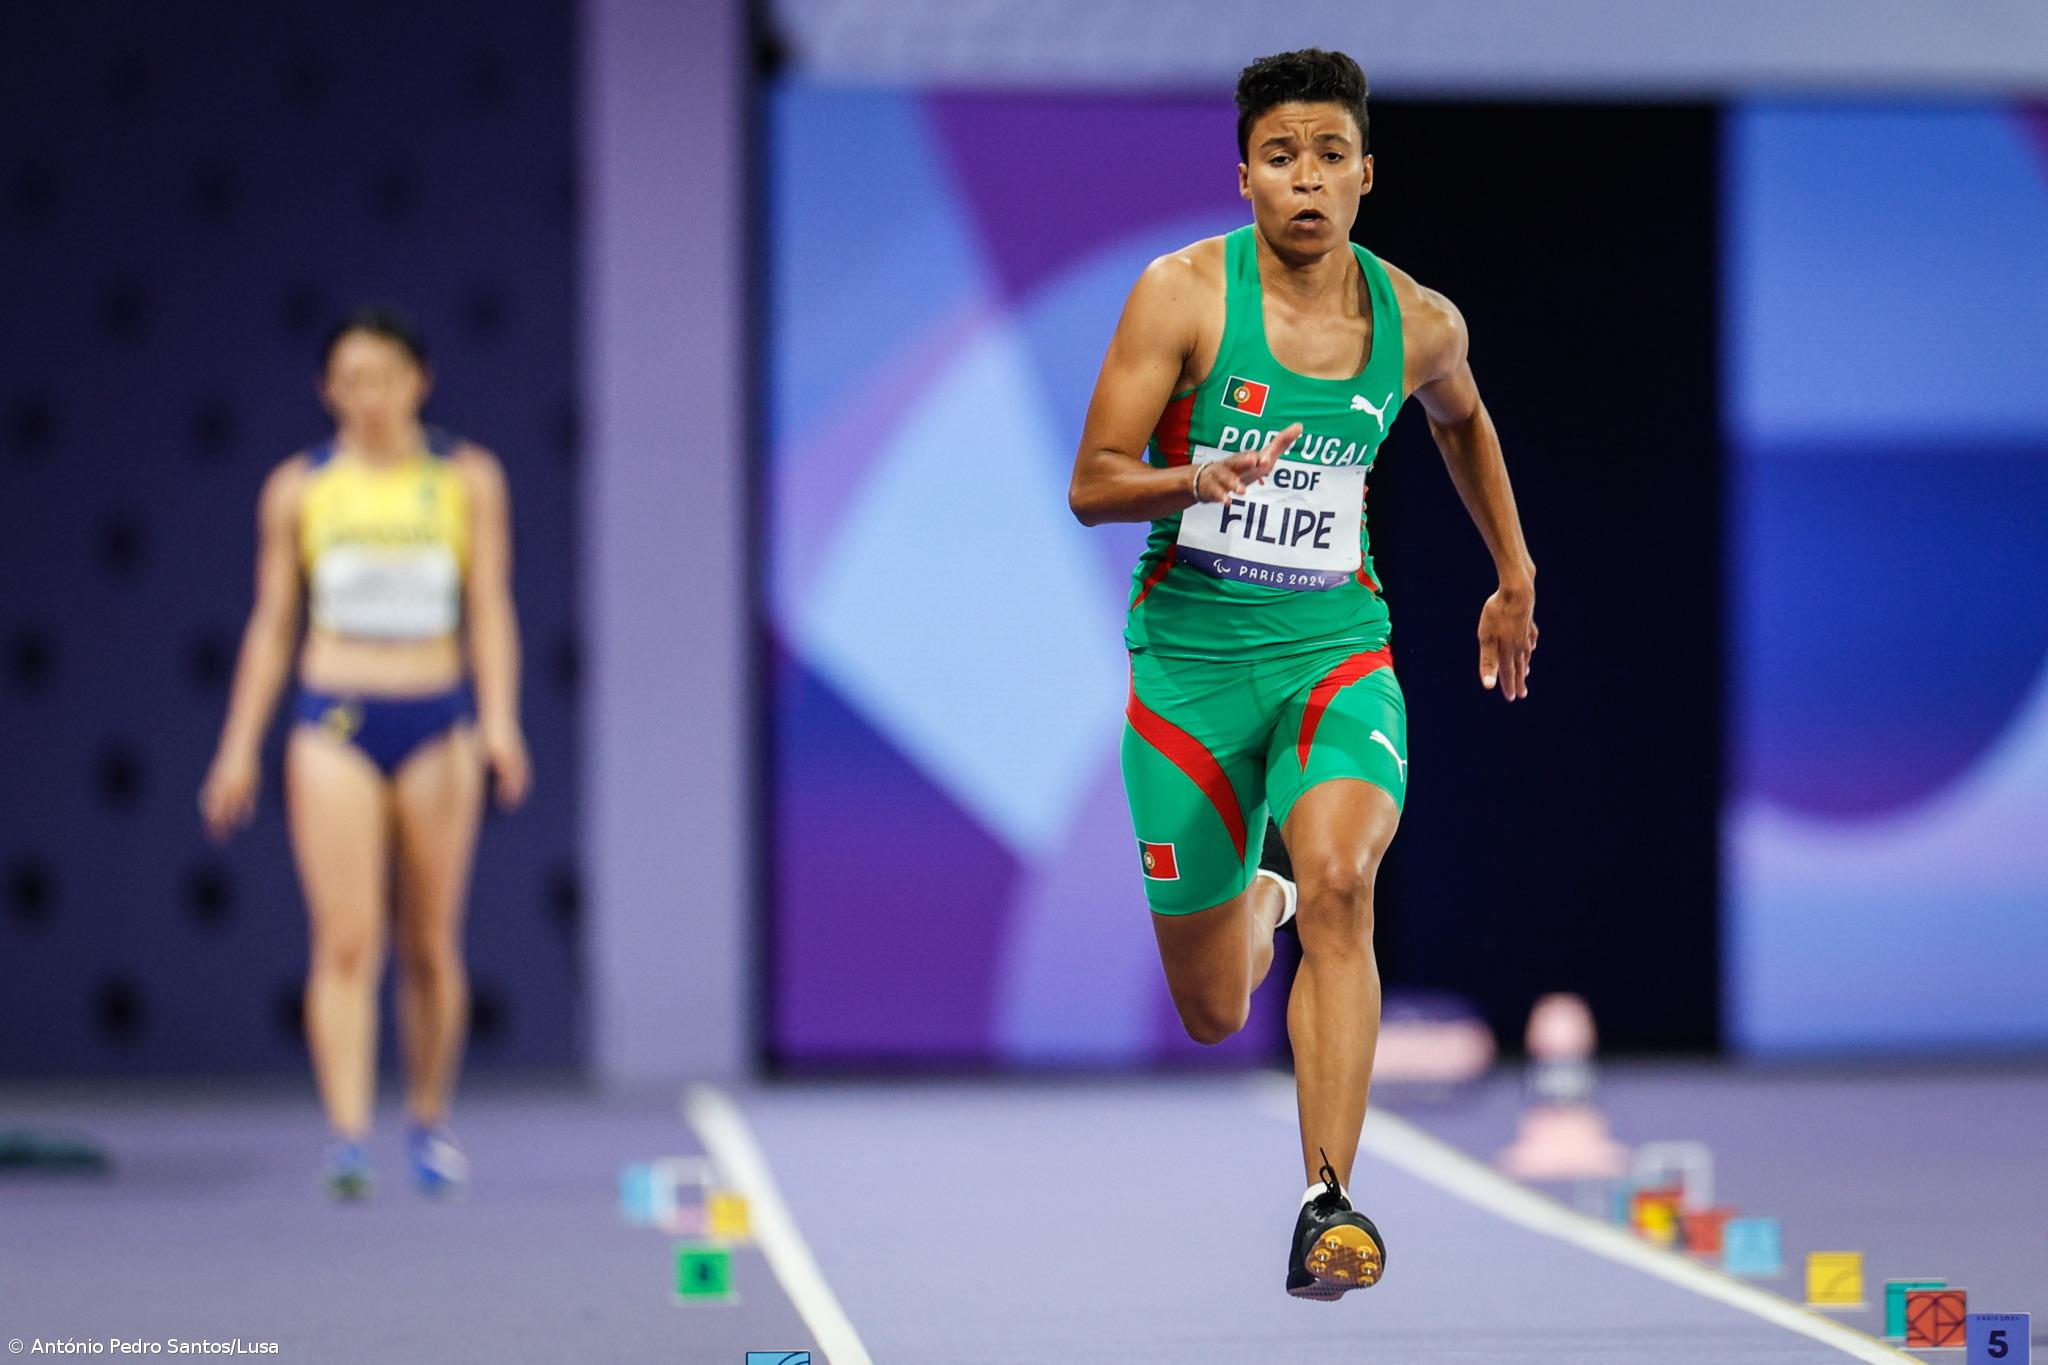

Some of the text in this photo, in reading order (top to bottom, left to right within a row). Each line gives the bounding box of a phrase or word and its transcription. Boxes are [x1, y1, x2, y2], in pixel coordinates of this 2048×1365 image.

[1219, 498, 1336, 550] FILIPE
[1239, 565, 1326, 588] PARIS 2024
[1987, 1330, 2009, 1359] 5
